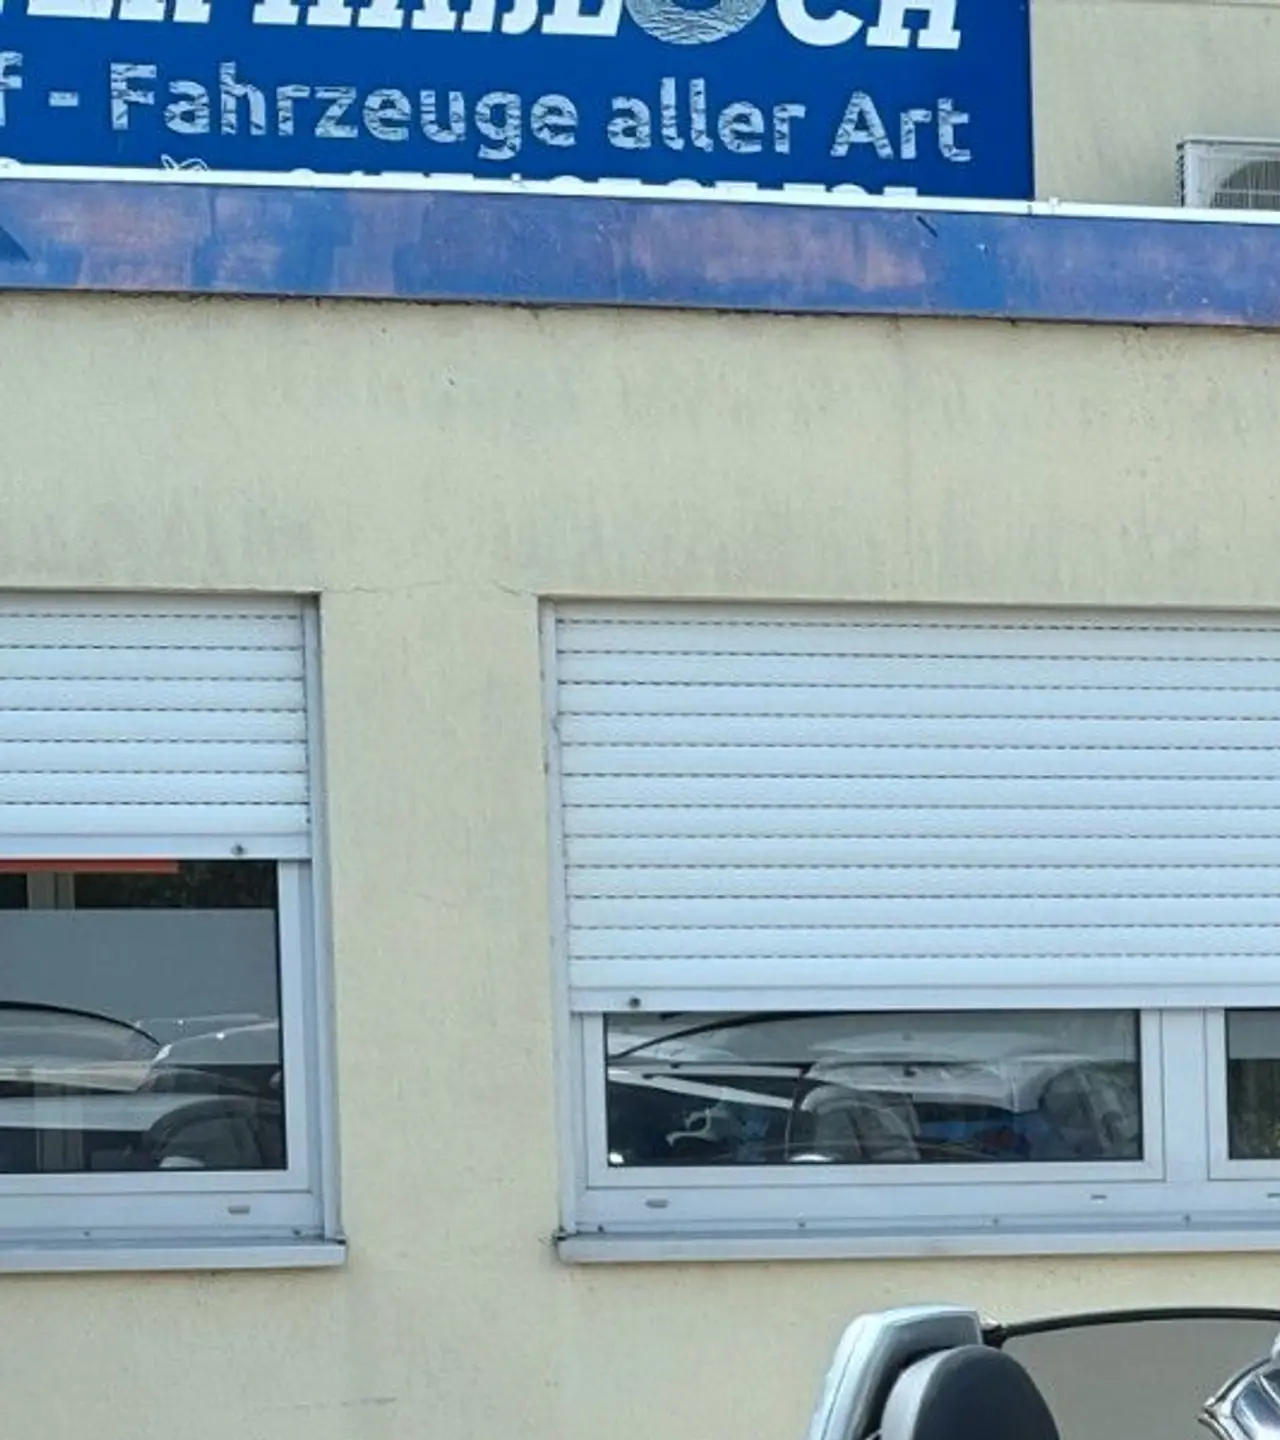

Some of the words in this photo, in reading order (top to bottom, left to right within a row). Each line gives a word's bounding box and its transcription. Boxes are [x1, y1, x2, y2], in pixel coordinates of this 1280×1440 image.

[110, 61, 578, 160] Fahrzeuge
[607, 77, 805, 154] aller
[830, 90, 972, 162] Art
